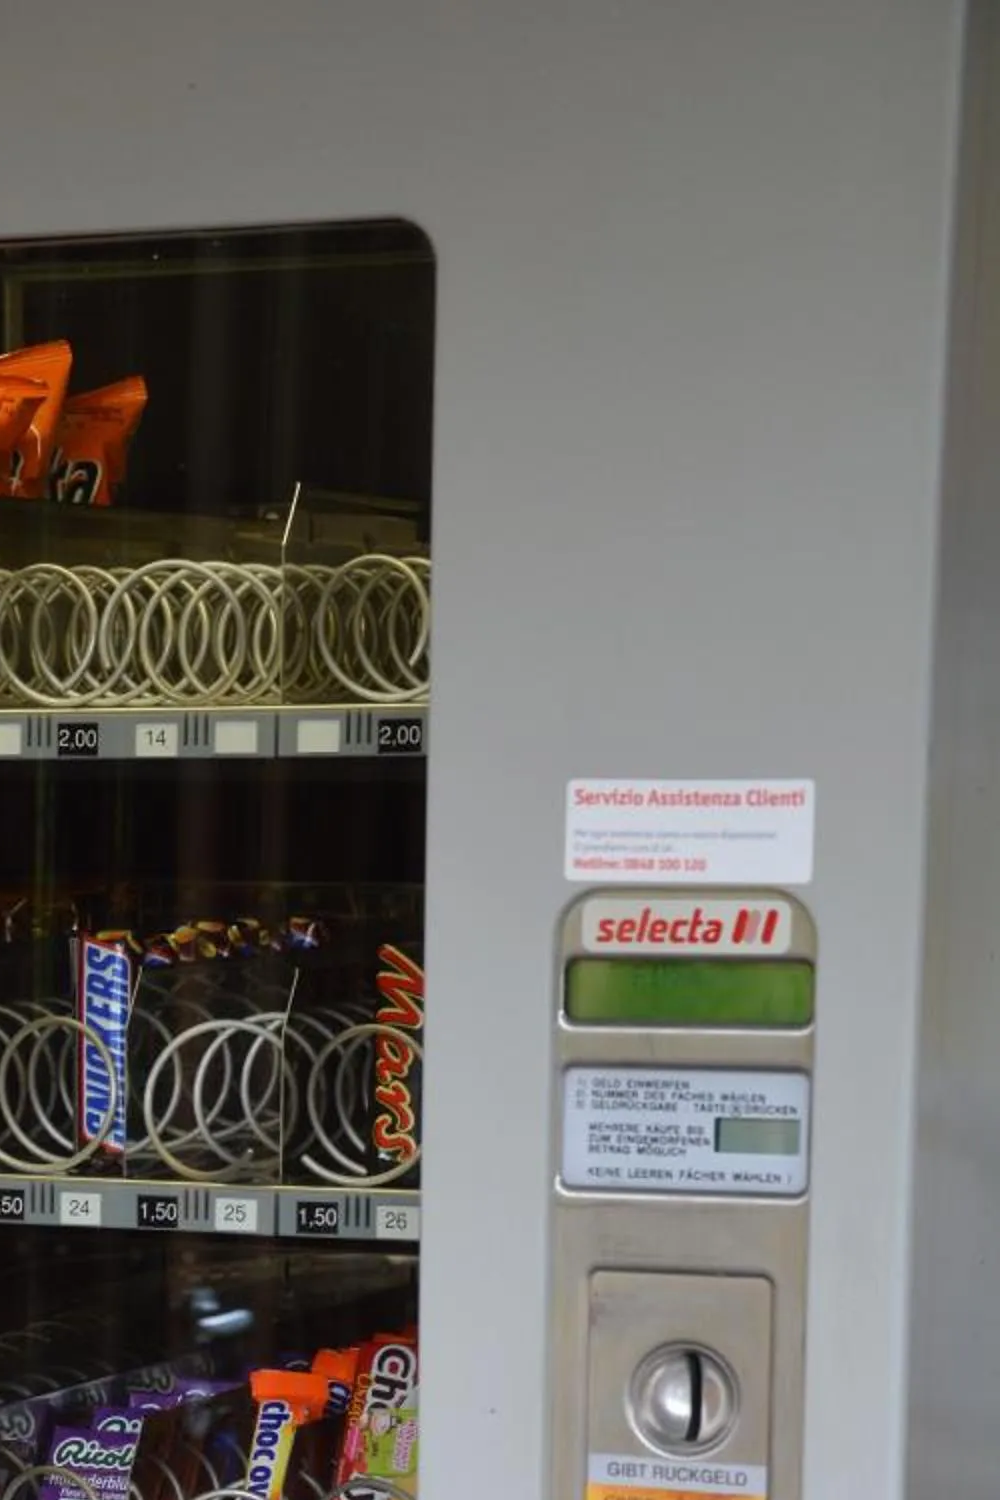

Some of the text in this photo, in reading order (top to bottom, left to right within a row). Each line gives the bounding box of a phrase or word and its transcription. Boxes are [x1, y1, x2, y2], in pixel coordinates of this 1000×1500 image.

[147, 729, 167, 747] 14
[574, 788, 805, 806] Servizio Assistenza Clienti
[596, 907, 723, 943] selecta
[86, 945, 130, 1147] SNICKERS
[69, 1200, 90, 1217] 24
[223, 1204, 246, 1222] 25
[385, 1211, 407, 1230] 26
[607, 1461, 648, 1479] GIBT
